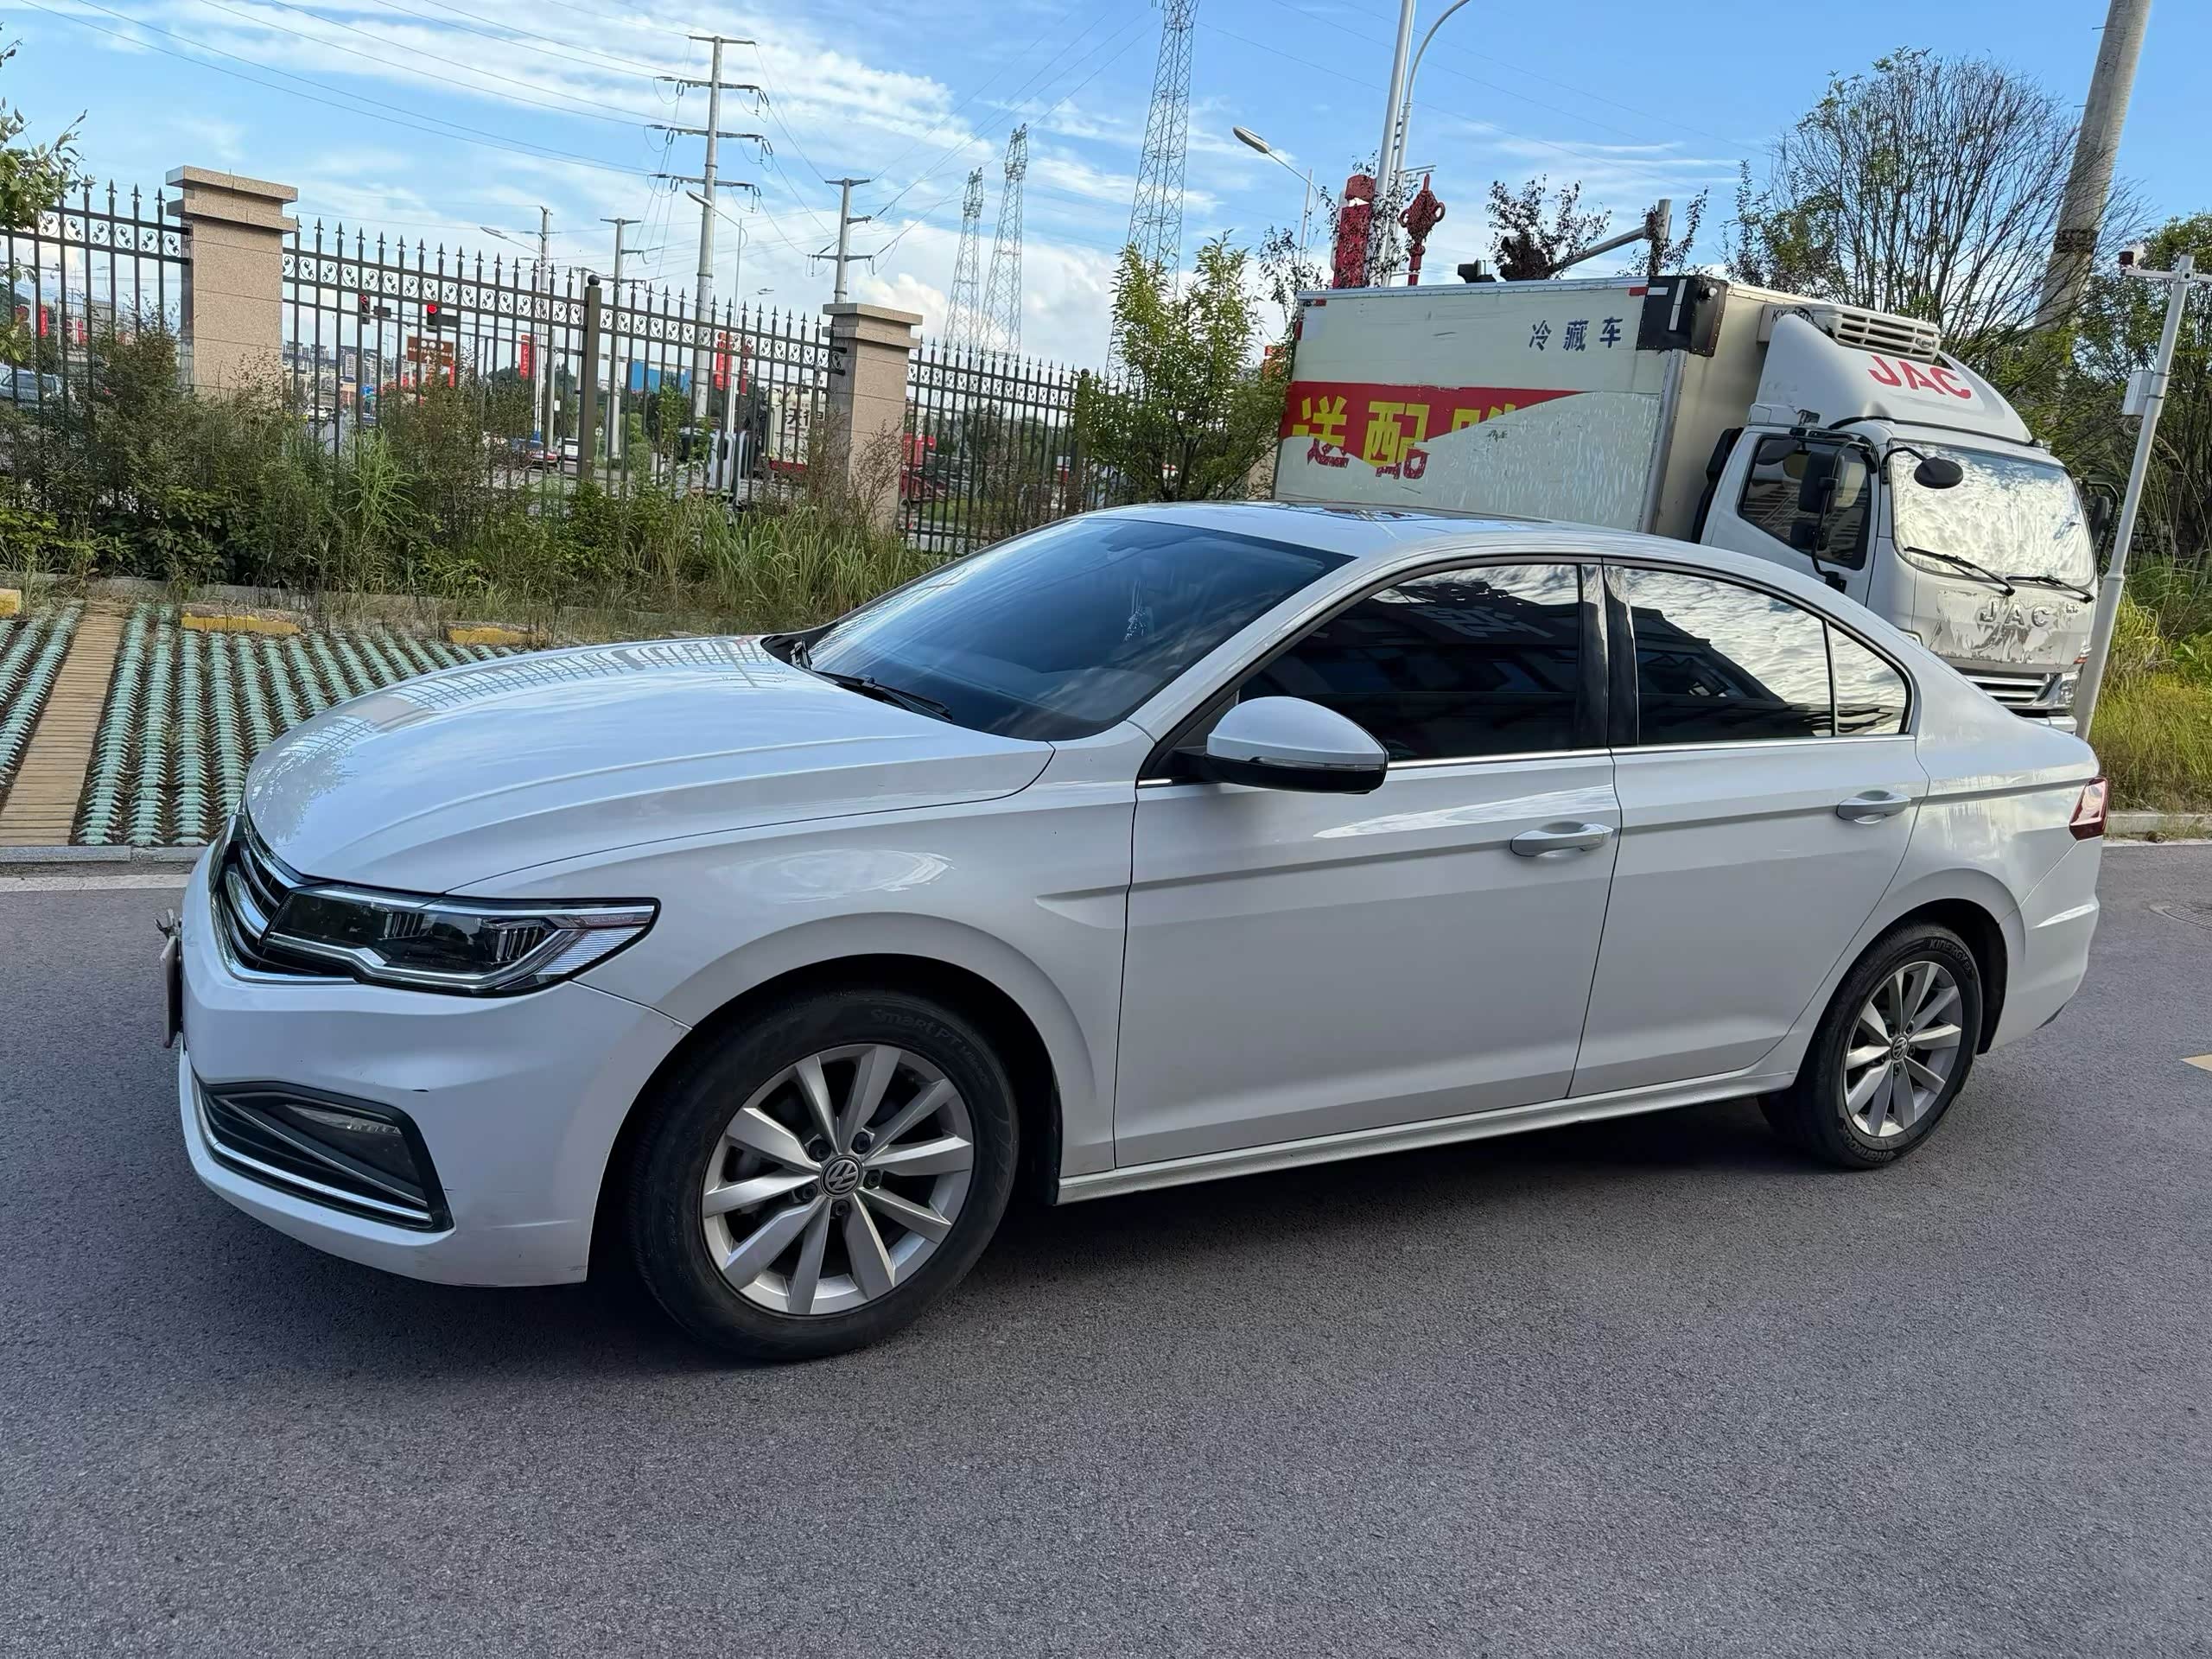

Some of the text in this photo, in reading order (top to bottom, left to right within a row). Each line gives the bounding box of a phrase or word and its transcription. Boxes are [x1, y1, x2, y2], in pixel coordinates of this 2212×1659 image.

[1529, 316, 1623, 351] 冷藏车
[1867, 355, 1971, 399] JAC
[1980, 600, 2050, 626] JAC
